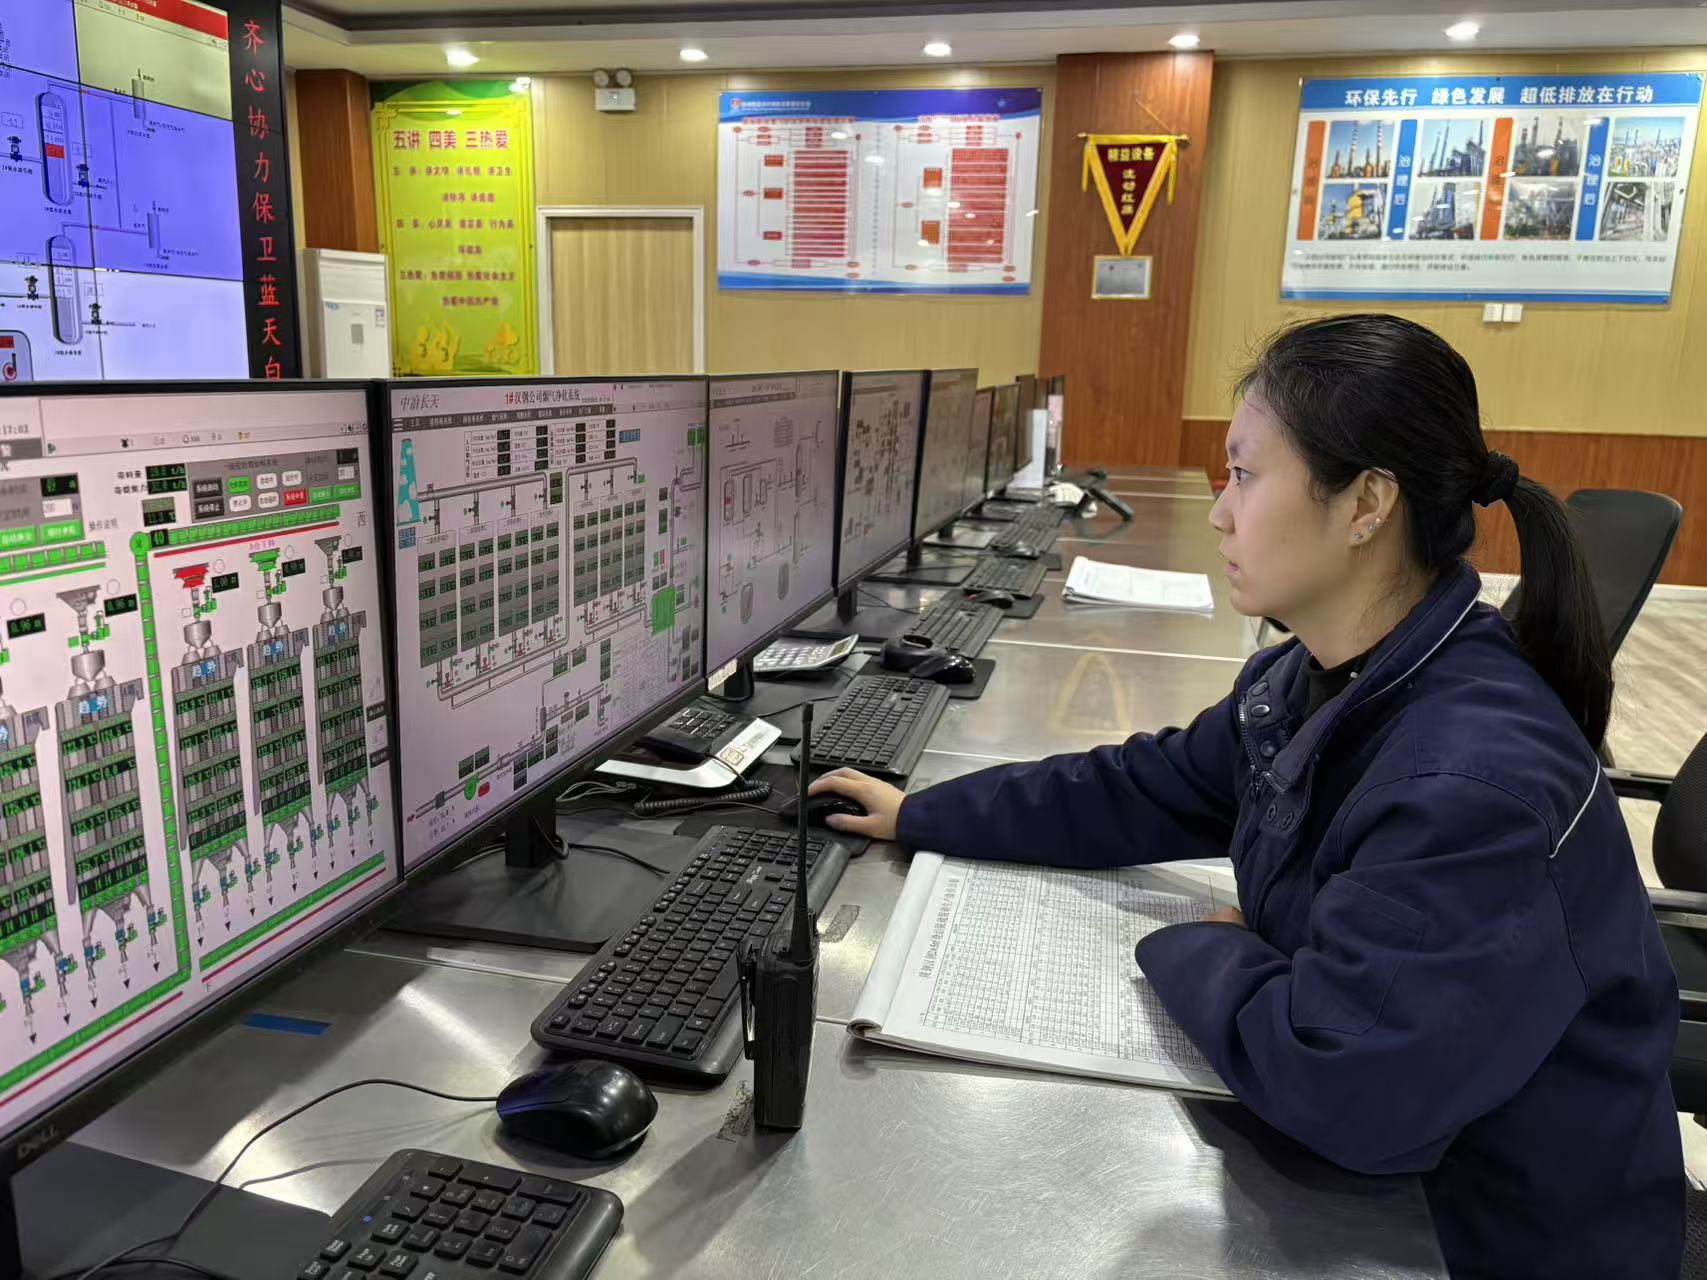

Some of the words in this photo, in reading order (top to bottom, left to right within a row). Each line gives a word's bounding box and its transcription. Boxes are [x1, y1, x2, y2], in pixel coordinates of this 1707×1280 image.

[1344, 88, 1418, 107] 环保先行
[1431, 87, 1505, 105] 绿色发展
[1519, 86, 1654, 105] 超低排放在行动
[393, 129, 421, 150] 五讲
[428, 129, 457, 149] 四美
[465, 129, 509, 149] 三热爱
[242, 19, 281, 380] 齐心协力保卫蓝天白
[192, 660, 216, 677] 趋势
[79, 694, 108, 714] 趋势
[16, 1124, 62, 1160] DELL
